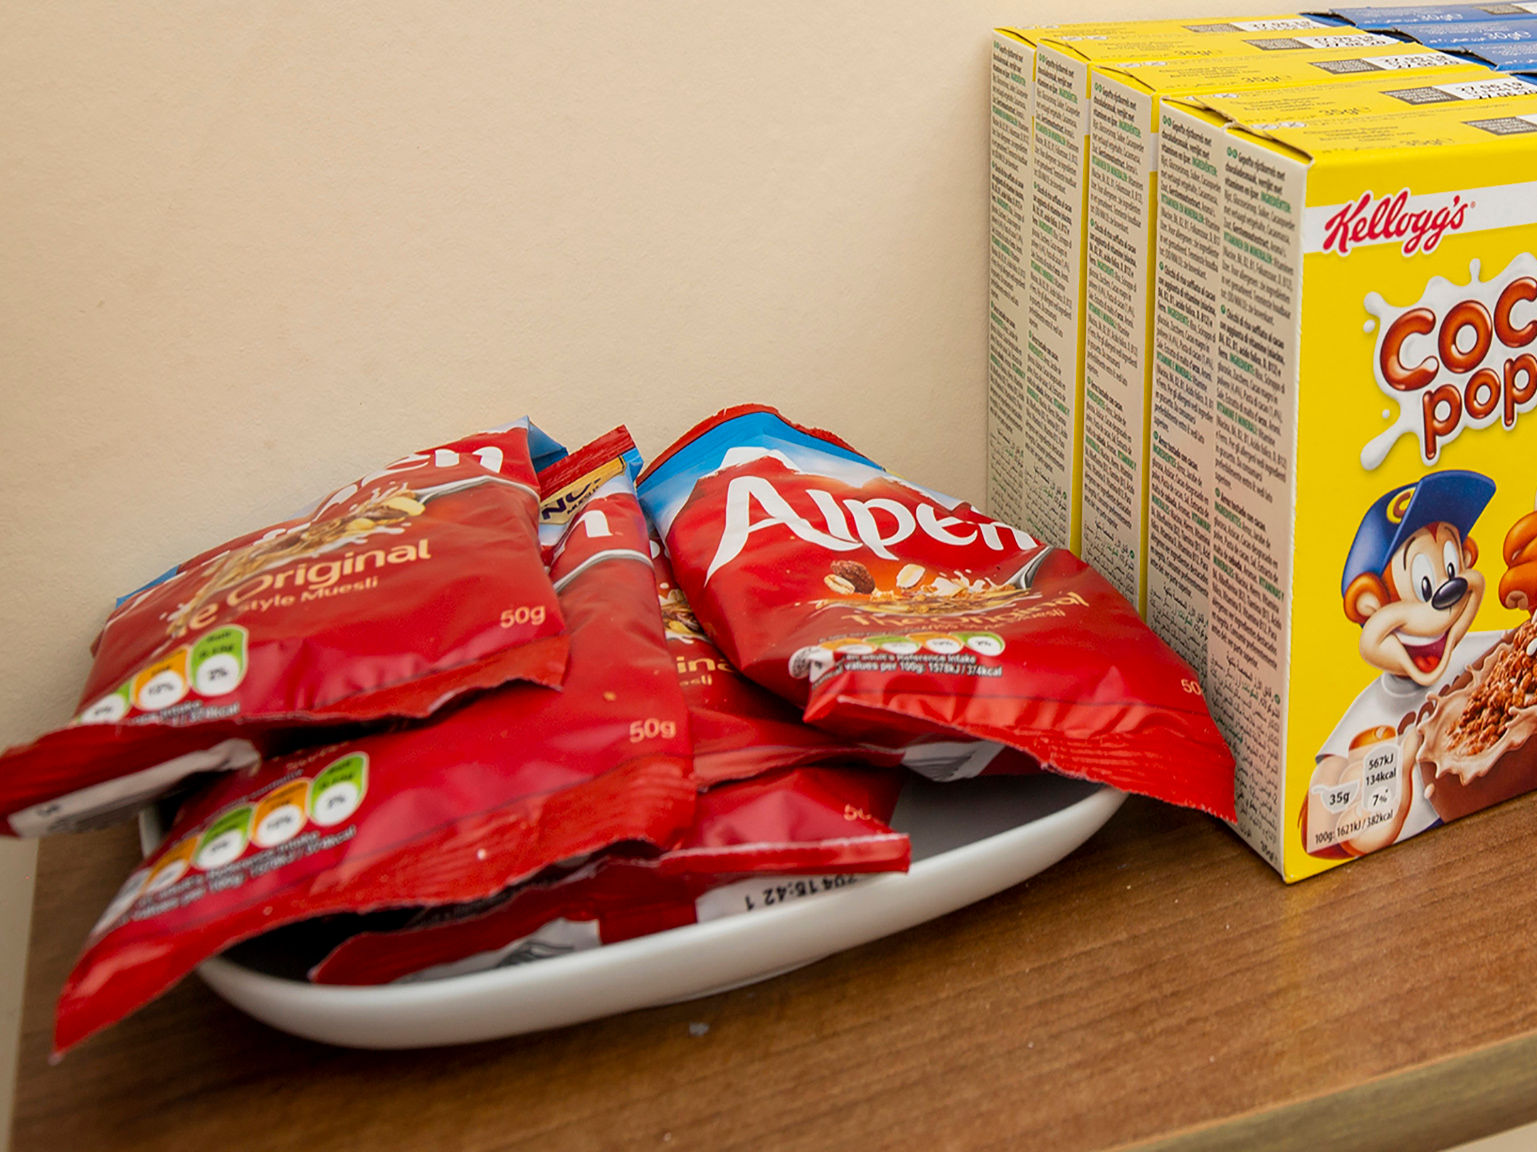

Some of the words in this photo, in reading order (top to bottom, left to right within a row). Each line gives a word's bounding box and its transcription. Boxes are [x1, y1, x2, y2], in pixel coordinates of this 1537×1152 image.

[1323, 190, 1469, 255] Kellogg's
[500, 603, 546, 629] 50g
[629, 717, 678, 744] 50g
[1368, 753, 1394, 771] 567kJ
[1365, 767, 1397, 786] 134kcal
[1329, 791, 1350, 806] 35g
[1315, 830, 1335, 845] 100g:
[1367, 810, 1394, 828] 382kcal
